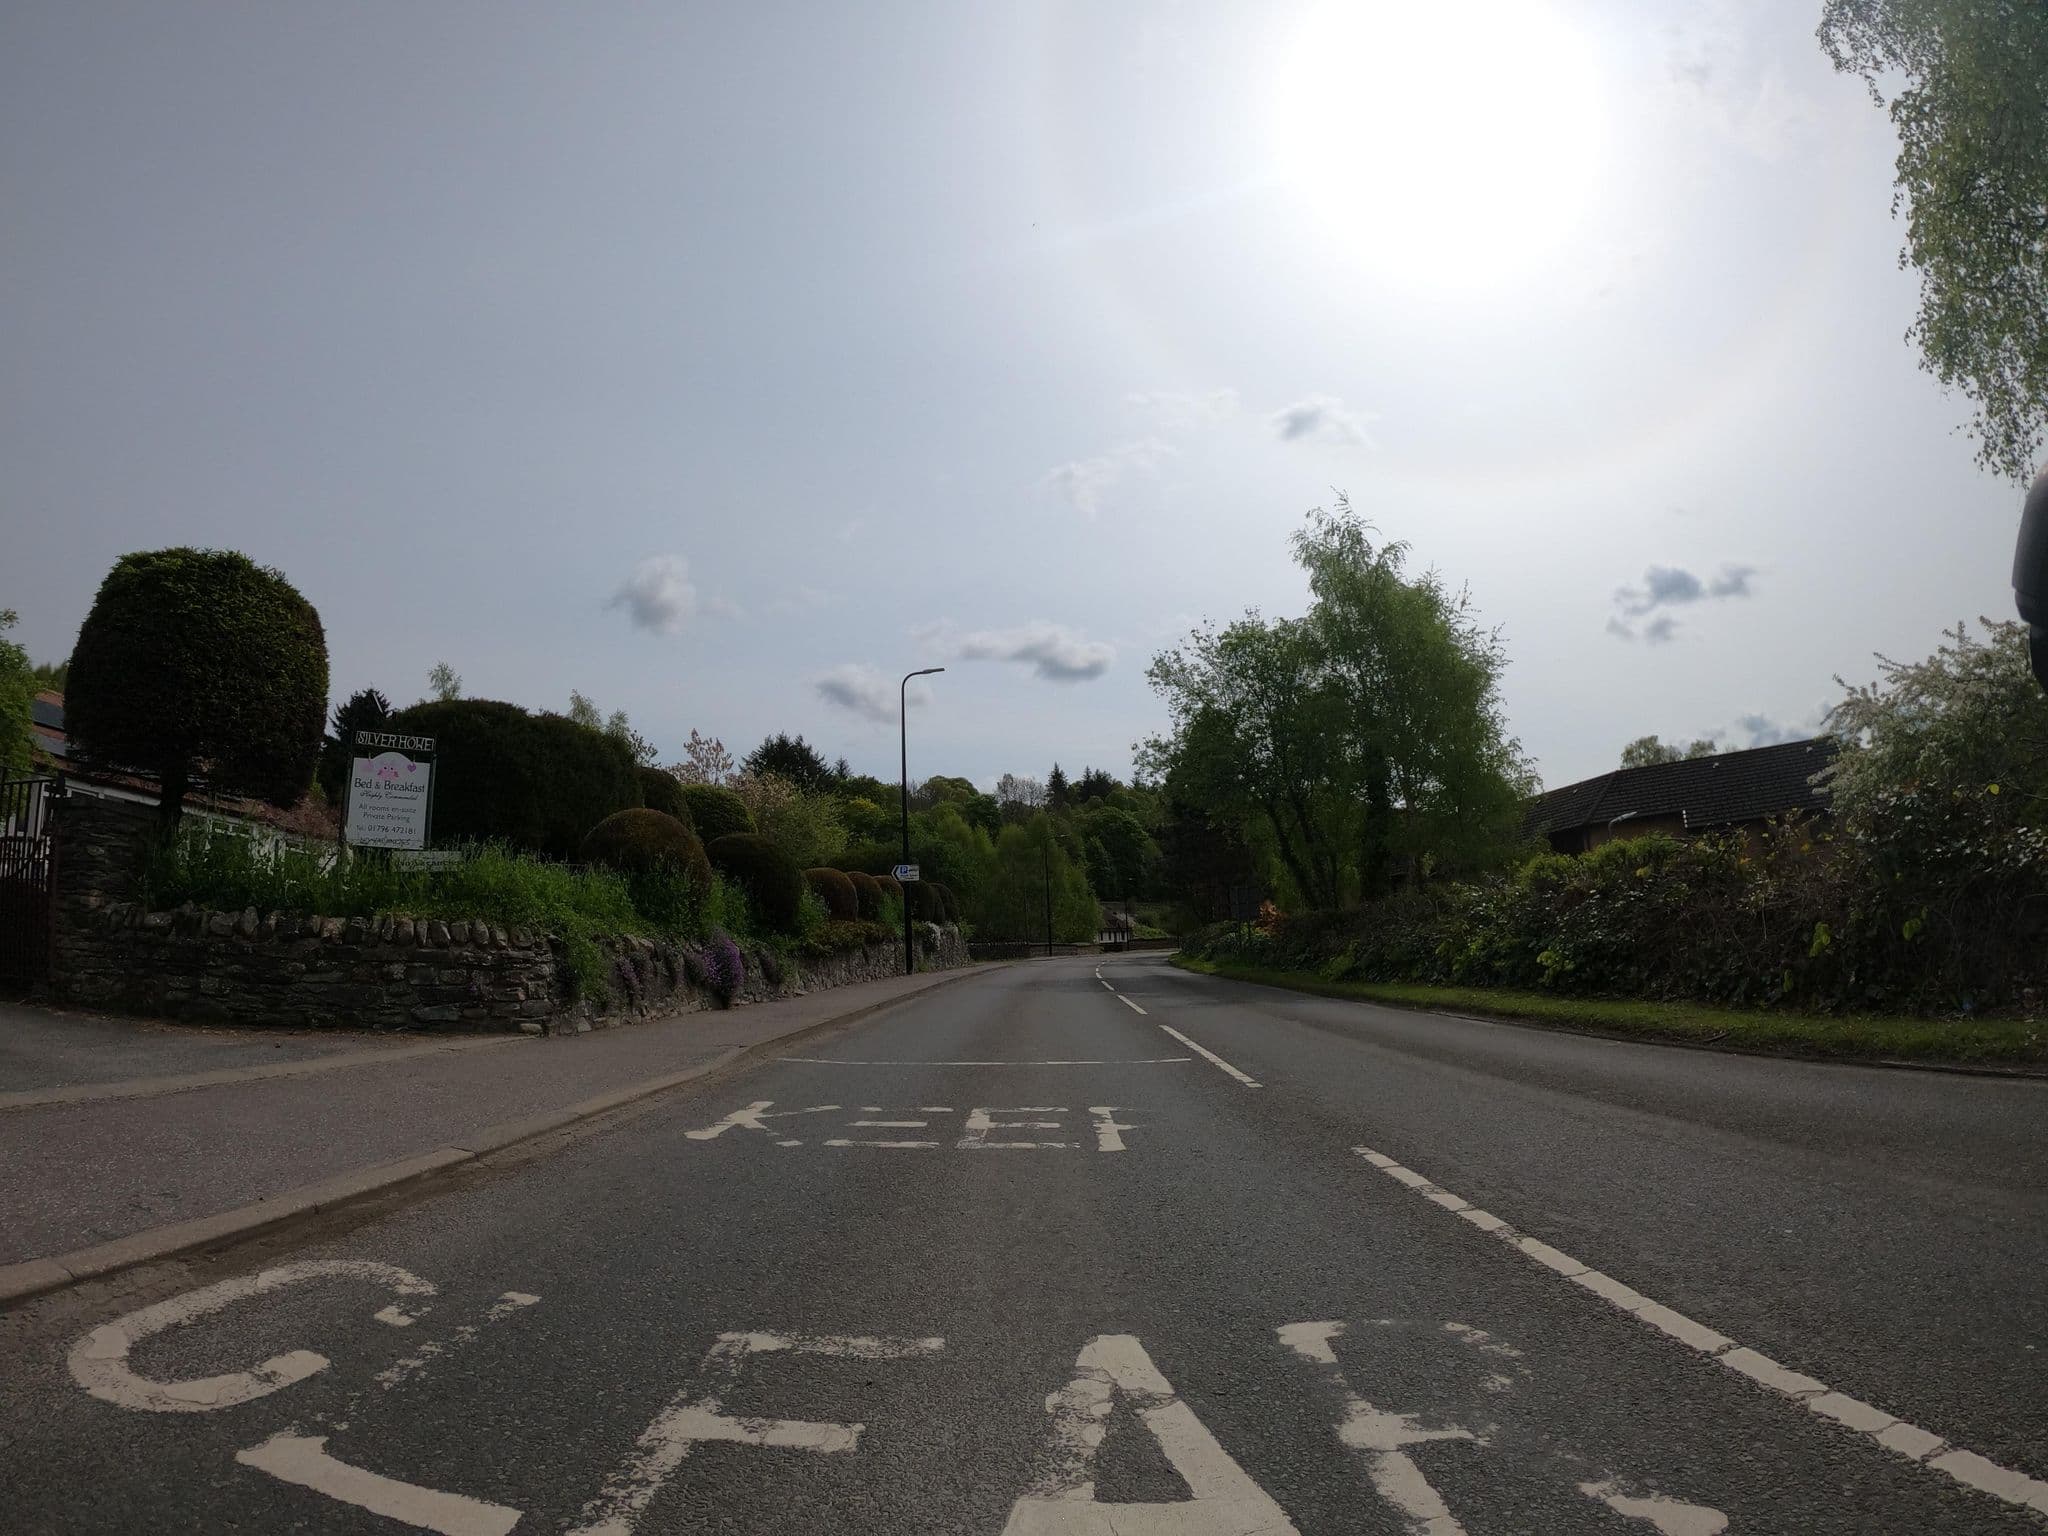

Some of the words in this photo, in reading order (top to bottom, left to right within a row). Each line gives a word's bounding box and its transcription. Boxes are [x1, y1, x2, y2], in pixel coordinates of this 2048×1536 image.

[354, 777, 372, 789] Bed
[384, 780, 425, 793] Breakfast
[362, 812, 385, 820] Private
[387, 814, 410, 823] Parking
